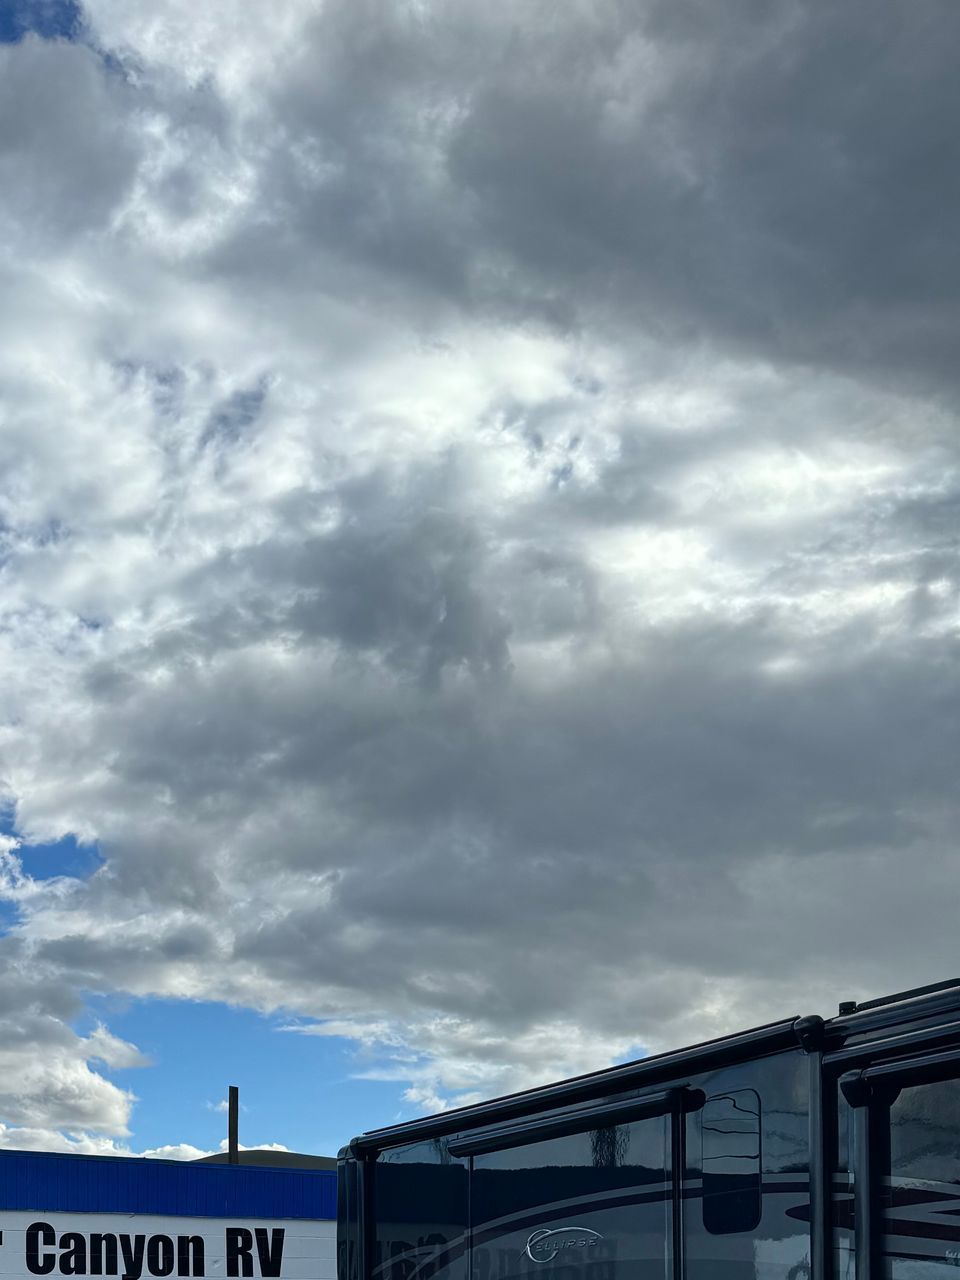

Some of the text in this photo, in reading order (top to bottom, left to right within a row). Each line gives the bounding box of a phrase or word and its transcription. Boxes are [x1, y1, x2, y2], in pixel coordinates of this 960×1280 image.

[26, 1222, 205, 1280] Canyon
[226, 1227, 285, 1278] RV
[536, 1236, 598, 1252] ELLIPSE
